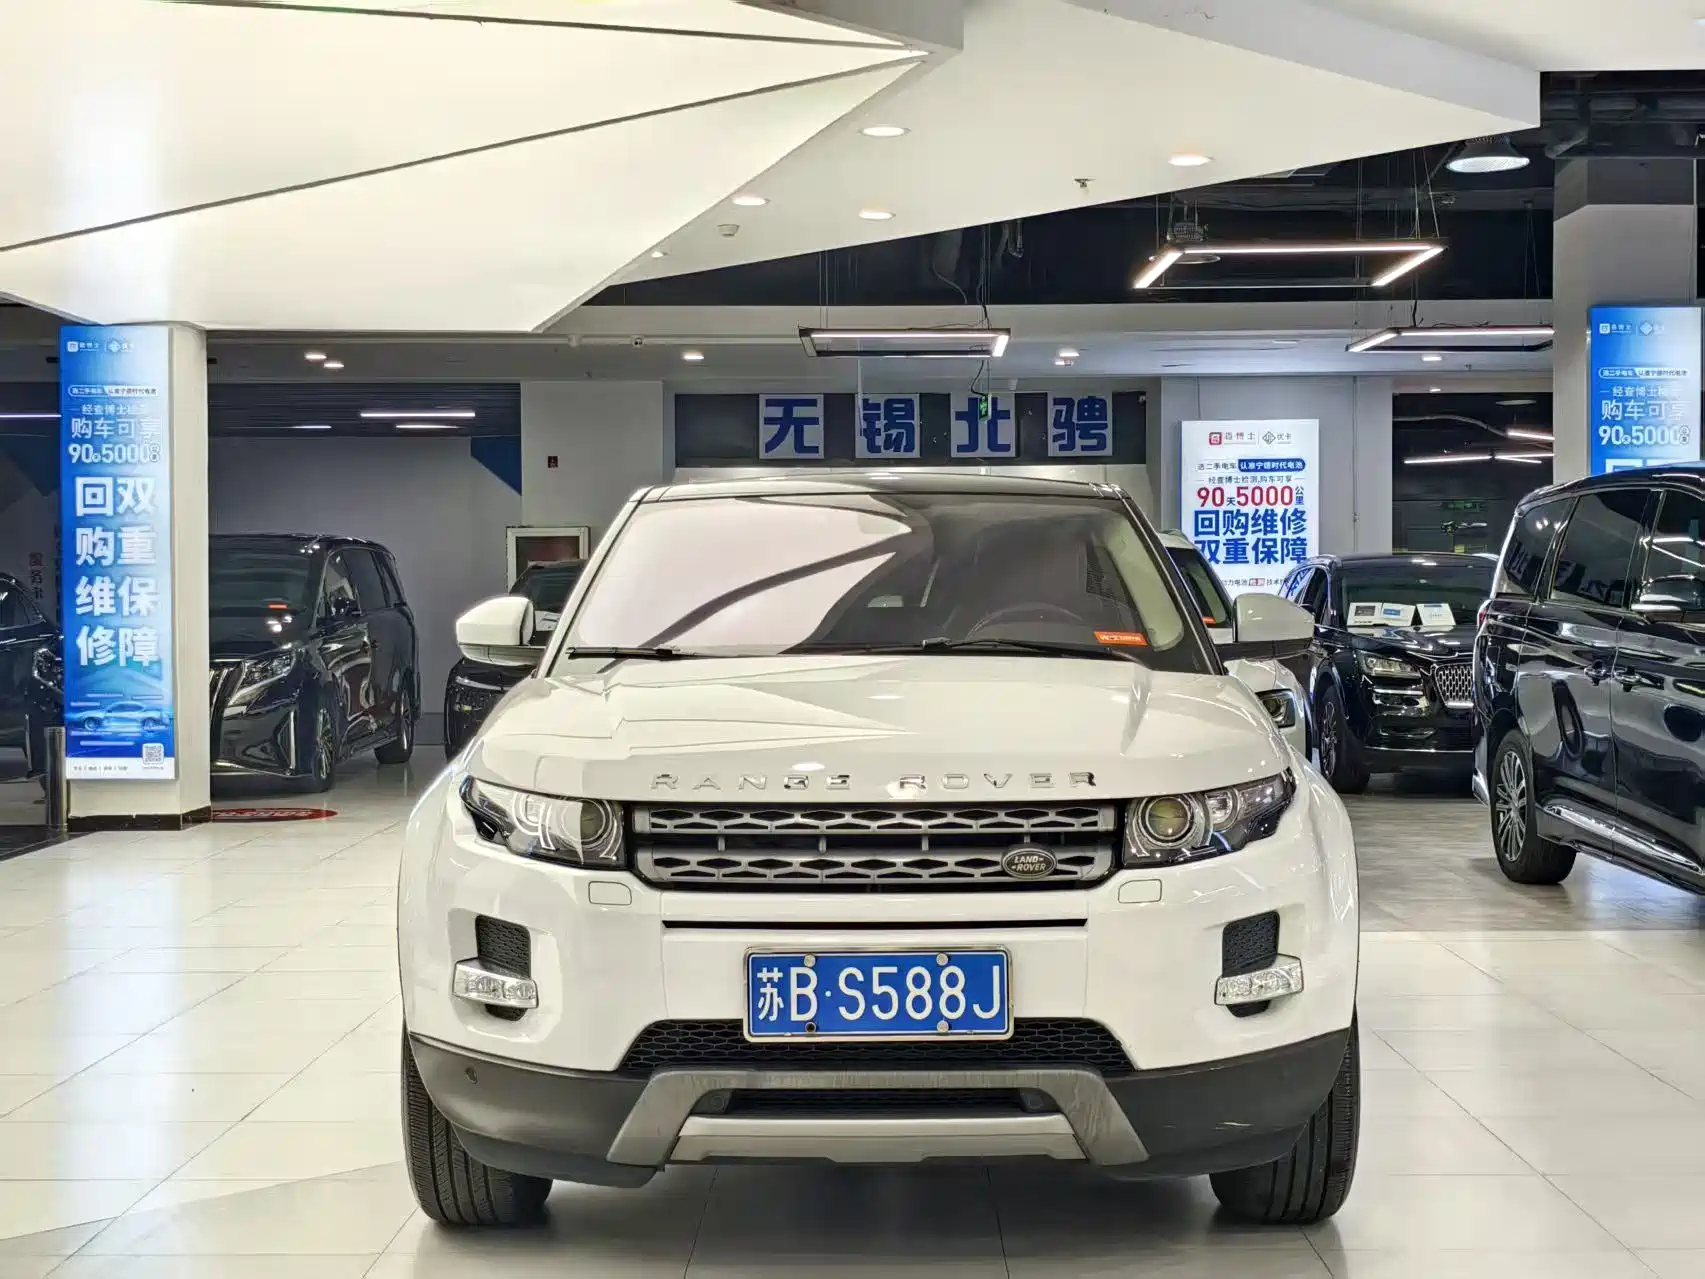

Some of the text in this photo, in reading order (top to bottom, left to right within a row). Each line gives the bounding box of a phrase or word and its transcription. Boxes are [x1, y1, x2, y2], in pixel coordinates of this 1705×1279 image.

[1194, 508, 1307, 537] 回购维修
[1194, 537, 1307, 565] 双重保障
[650, 771, 1097, 791] RANGE ROVER
[1014, 855, 1039, 864] LAND
[1016, 863, 1047, 872] ROVER
